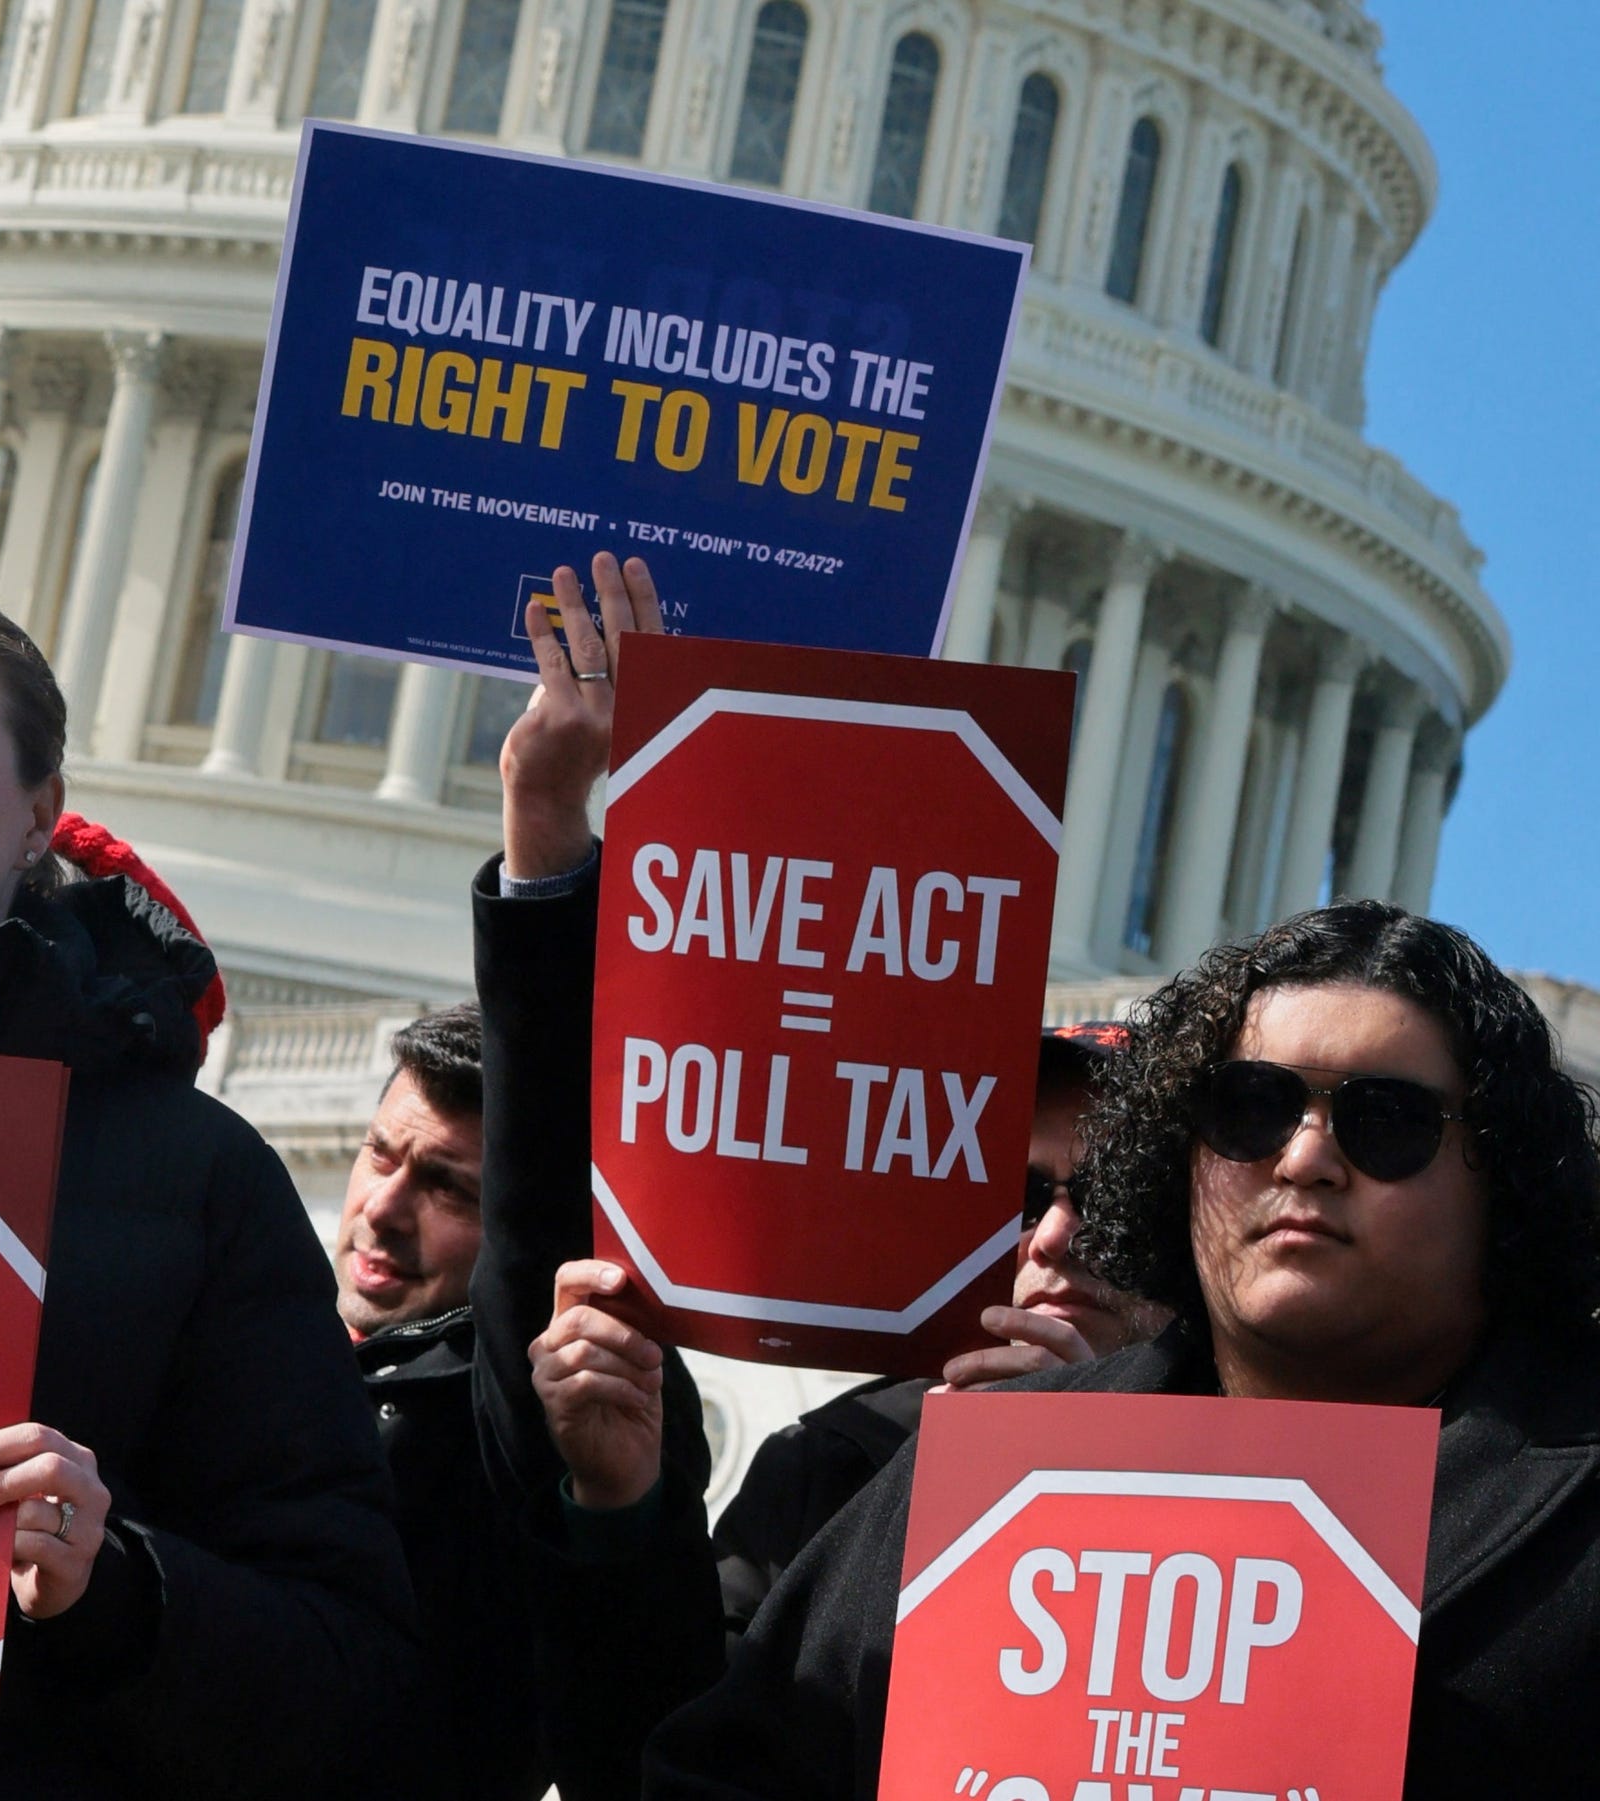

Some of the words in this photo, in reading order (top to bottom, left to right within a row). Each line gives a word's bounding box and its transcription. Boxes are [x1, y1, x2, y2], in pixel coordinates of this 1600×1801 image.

[356, 266, 596, 357] EQUALITY
[603, 305, 832, 401] INCLUDES
[850, 349, 935, 420] THE
[341, 338, 586, 450] RIGHT
[611, 379, 712, 472] TO
[737, 402, 921, 512] VOTE
[378, 480, 426, 504] JOIN
[431, 488, 472, 511] THE
[476, 496, 600, 532] MOVEMENT
[627, 520, 680, 546] TEXT
[746, 542, 772, 563] TO
[627, 843, 834, 969] SAVE
[846, 866, 1021, 985] ACT
[780, 990, 834, 1033] =
[620, 1037, 808, 1165] POLL
[836, 1063, 998, 1183] TAX
[999, 1547, 1303, 1705] STOP
[1088, 1709, 1186, 1778] THE
